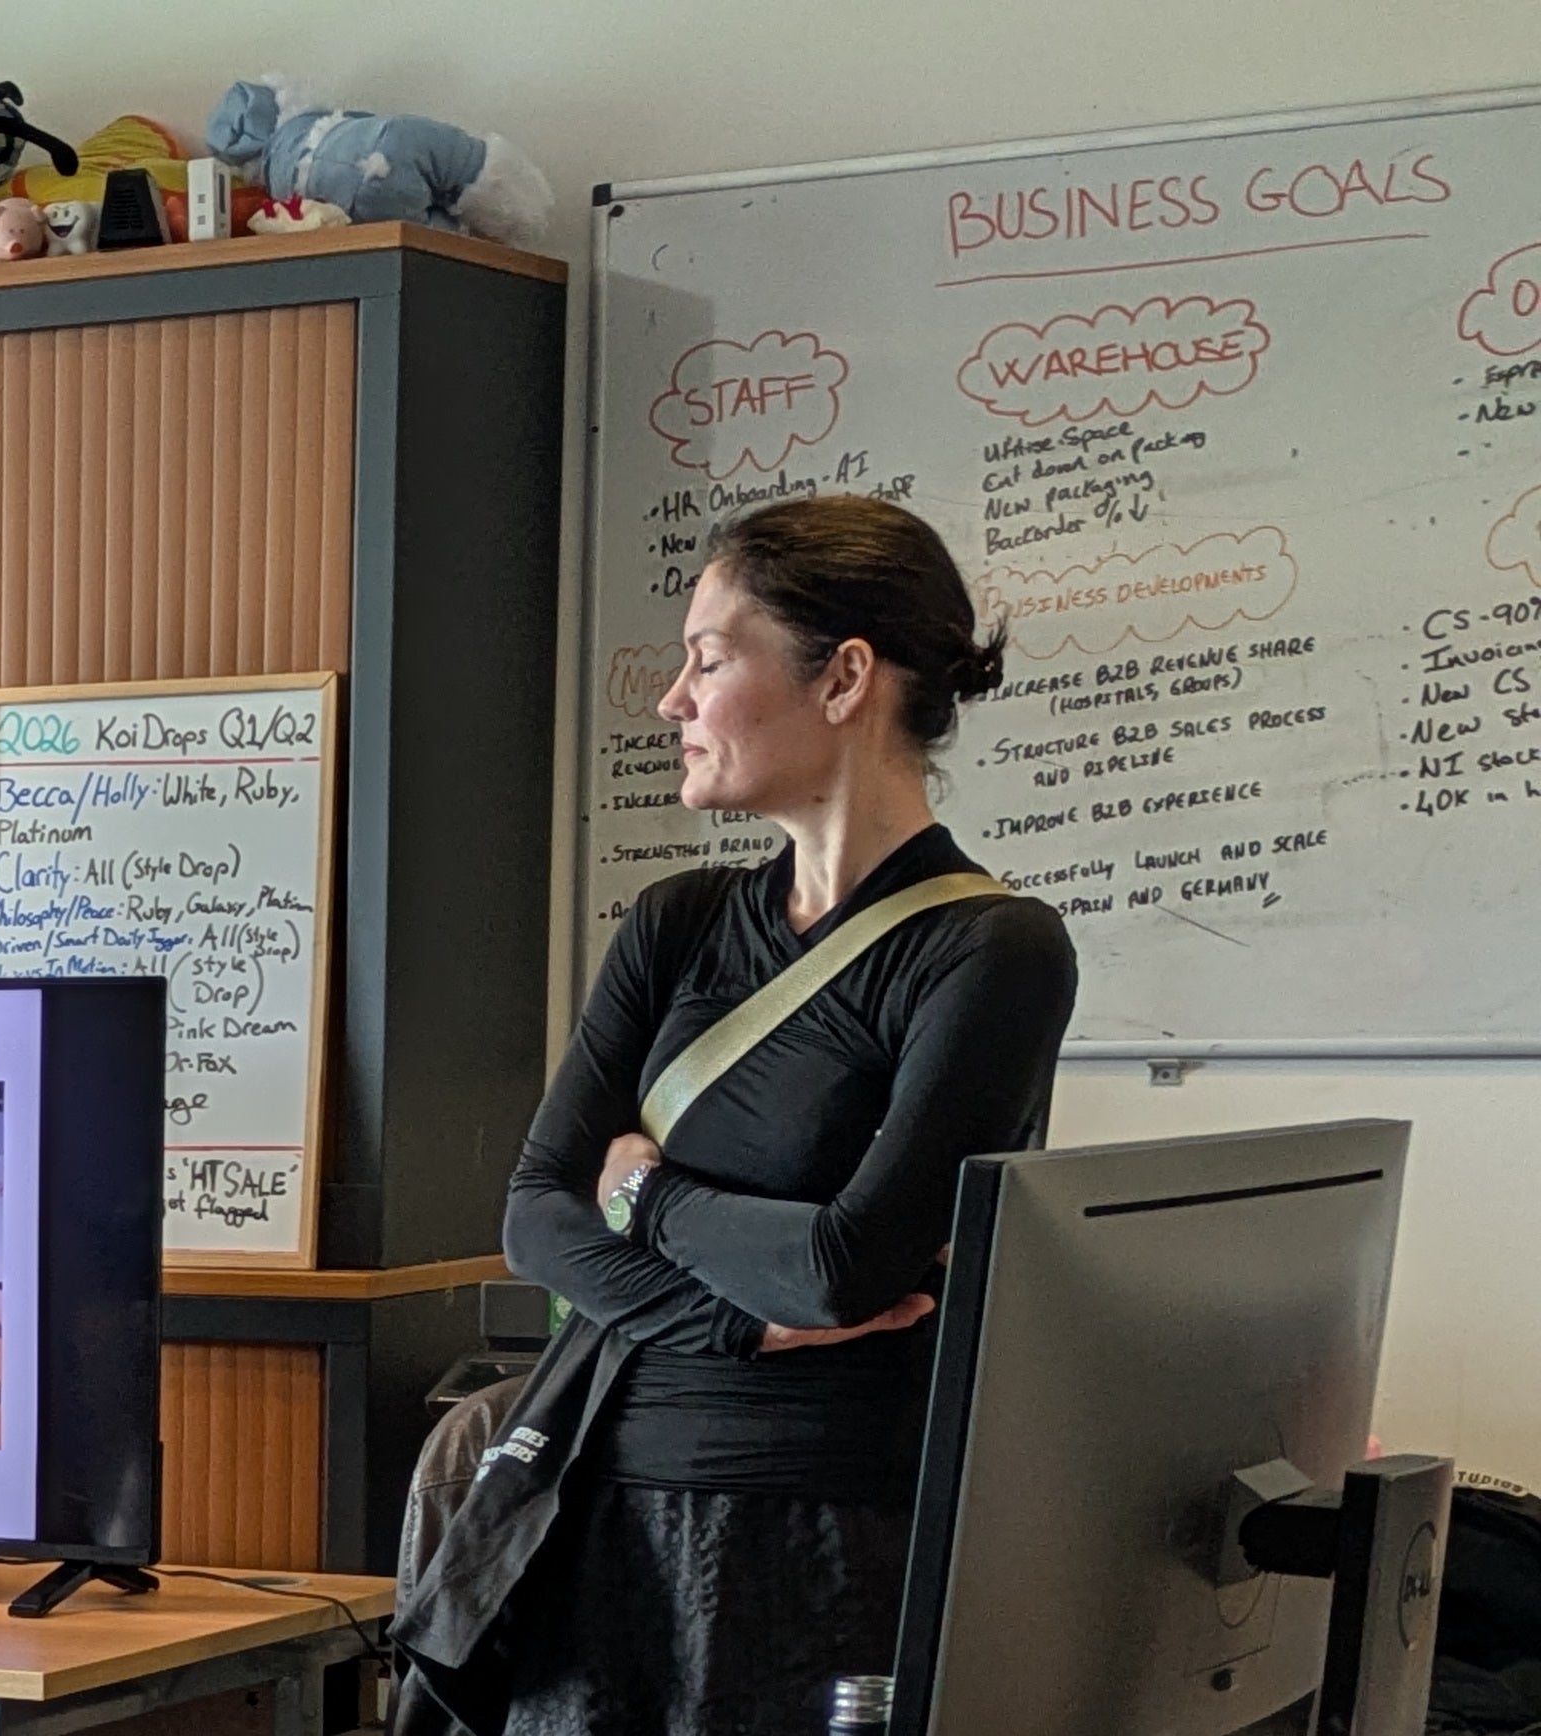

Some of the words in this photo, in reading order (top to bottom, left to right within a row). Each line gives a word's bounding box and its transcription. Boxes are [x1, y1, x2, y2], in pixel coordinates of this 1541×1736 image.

[949, 176, 1219, 257] BUSINESS
[1246, 154, 1450, 217] GOALS
[989, 331, 1245, 388] WAREHOUSE
[685, 374, 815, 425] STAFF
[663, 491, 701, 522] HR
[1096, 660, 1141, 686] B2B
[1151, 645, 1238, 676] REVENUE
[1249, 637, 1315, 659] SHARE
[96, 717, 138, 750] Koi
[143, 713, 207, 755] Drops
[220, 705, 315, 750] Q1/Q2
[1170, 717, 1231, 738] SALES
[1249, 706, 1327, 731] PROCESS
[223, 1017, 296, 1037] Dream
[1452, 1470, 1524, 1493] TUDIOS
